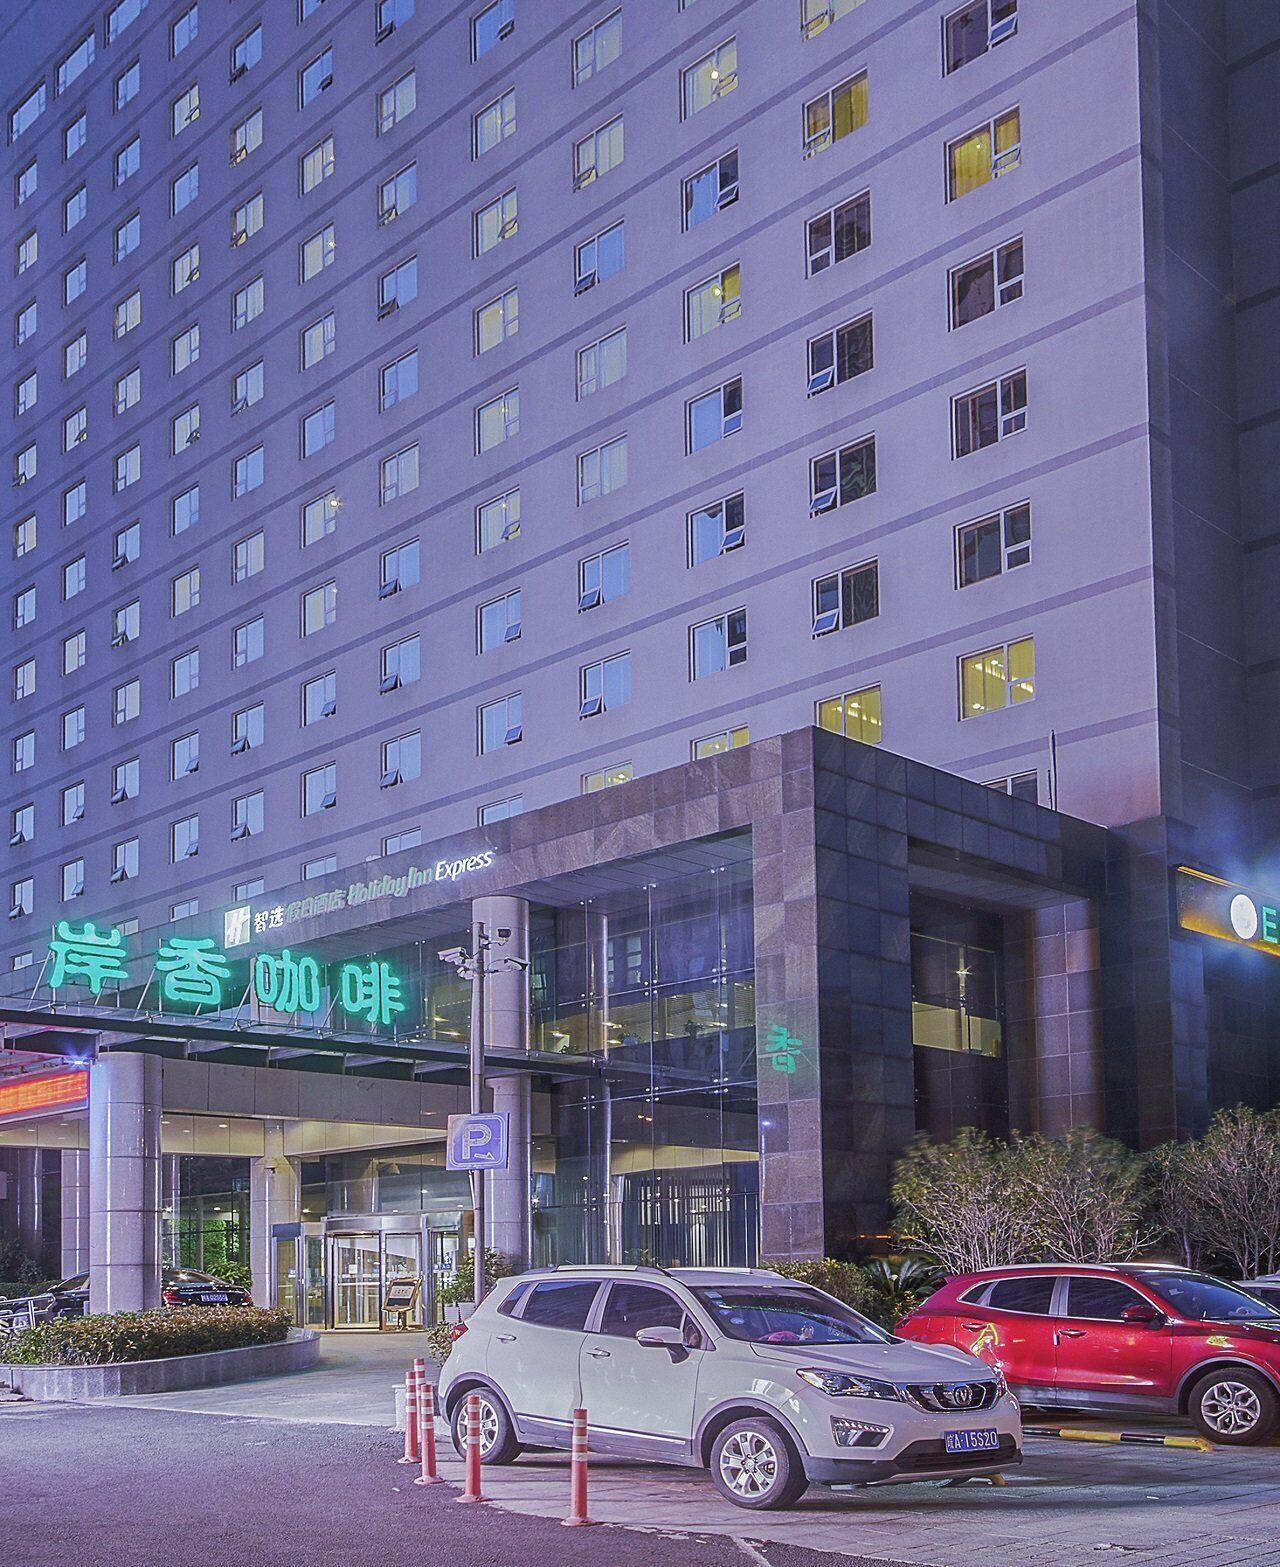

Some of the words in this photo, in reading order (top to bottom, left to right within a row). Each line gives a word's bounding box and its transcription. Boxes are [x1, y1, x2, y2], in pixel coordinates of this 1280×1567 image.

[347, 874, 409, 906] Holiday
[406, 866, 433, 890] Inn
[434, 850, 496, 883] Express
[48, 921, 405, 1025] 岸香咖啡
[462, 1123, 492, 1160] P
